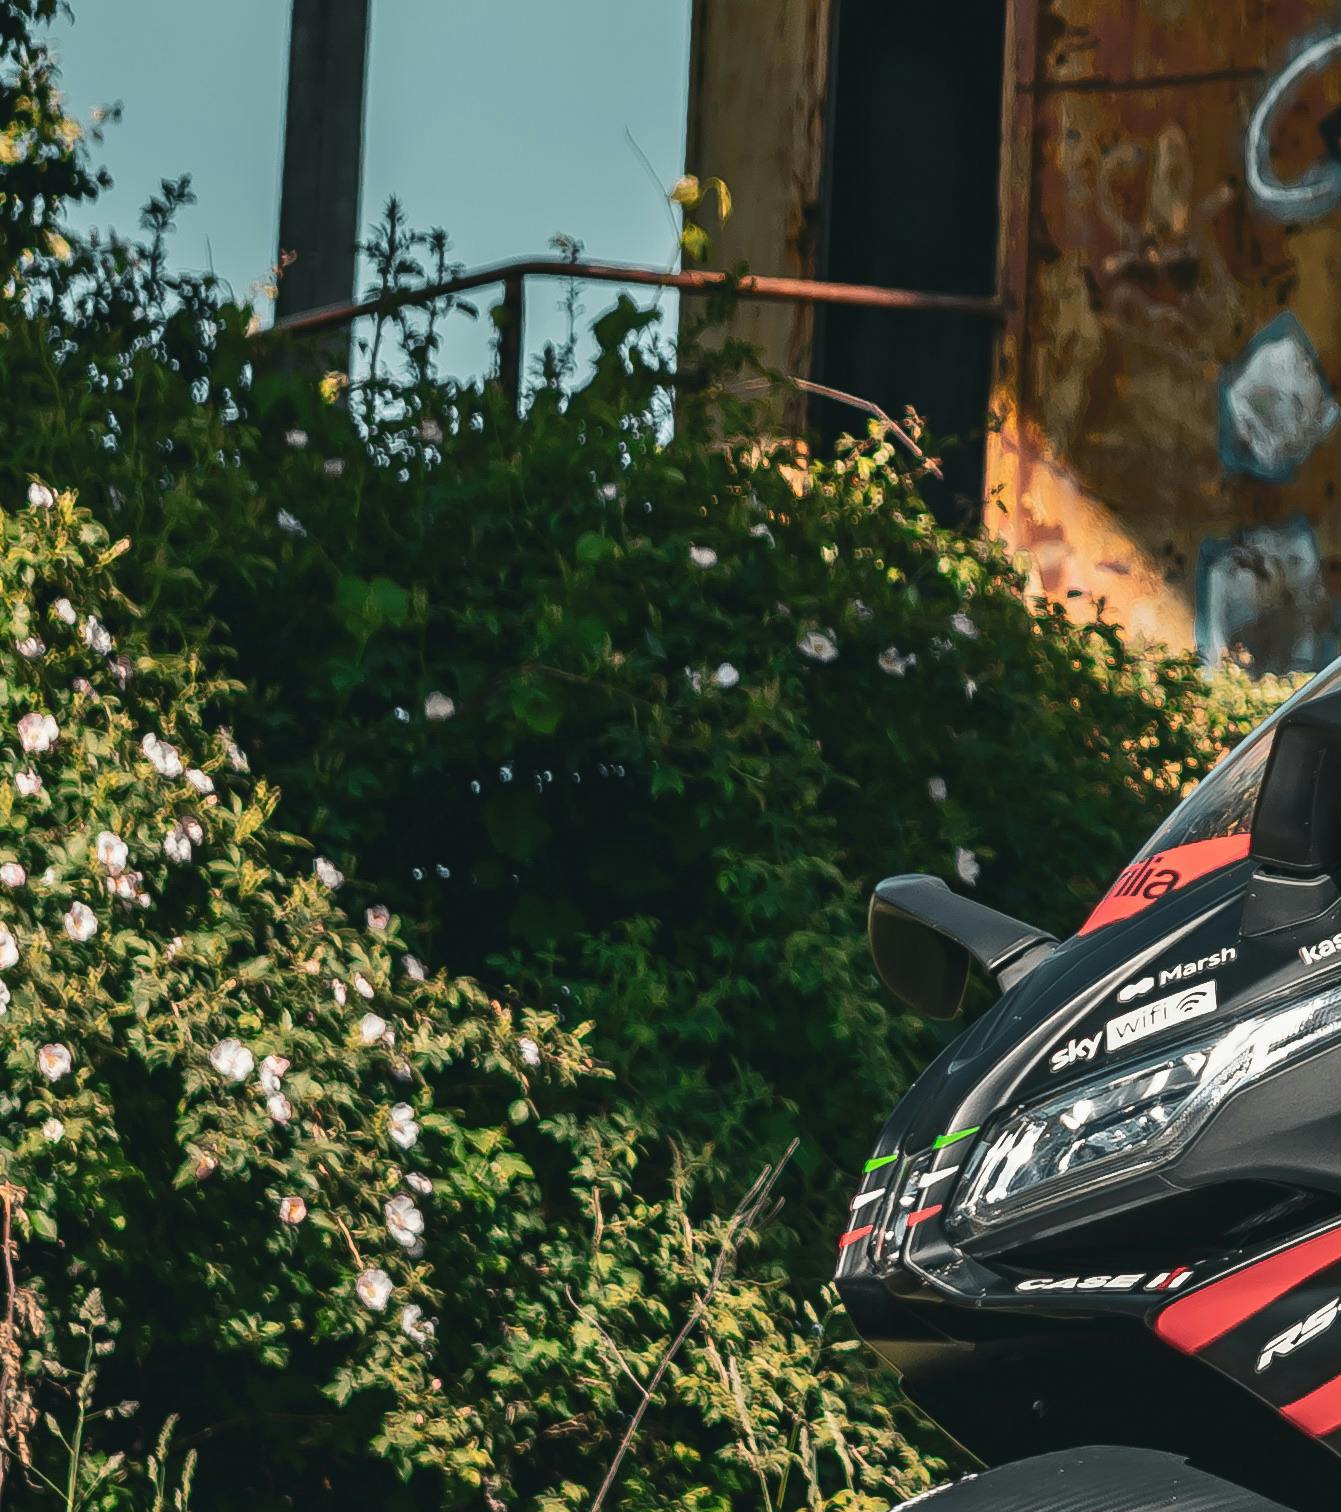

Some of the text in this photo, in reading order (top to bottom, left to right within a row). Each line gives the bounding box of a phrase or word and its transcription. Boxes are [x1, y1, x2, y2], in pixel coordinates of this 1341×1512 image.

[1159, 946, 1237, 986] Marsh
[1049, 1004, 1169, 1073] sky wifi
[1015, 1273, 1147, 1292] CASE
